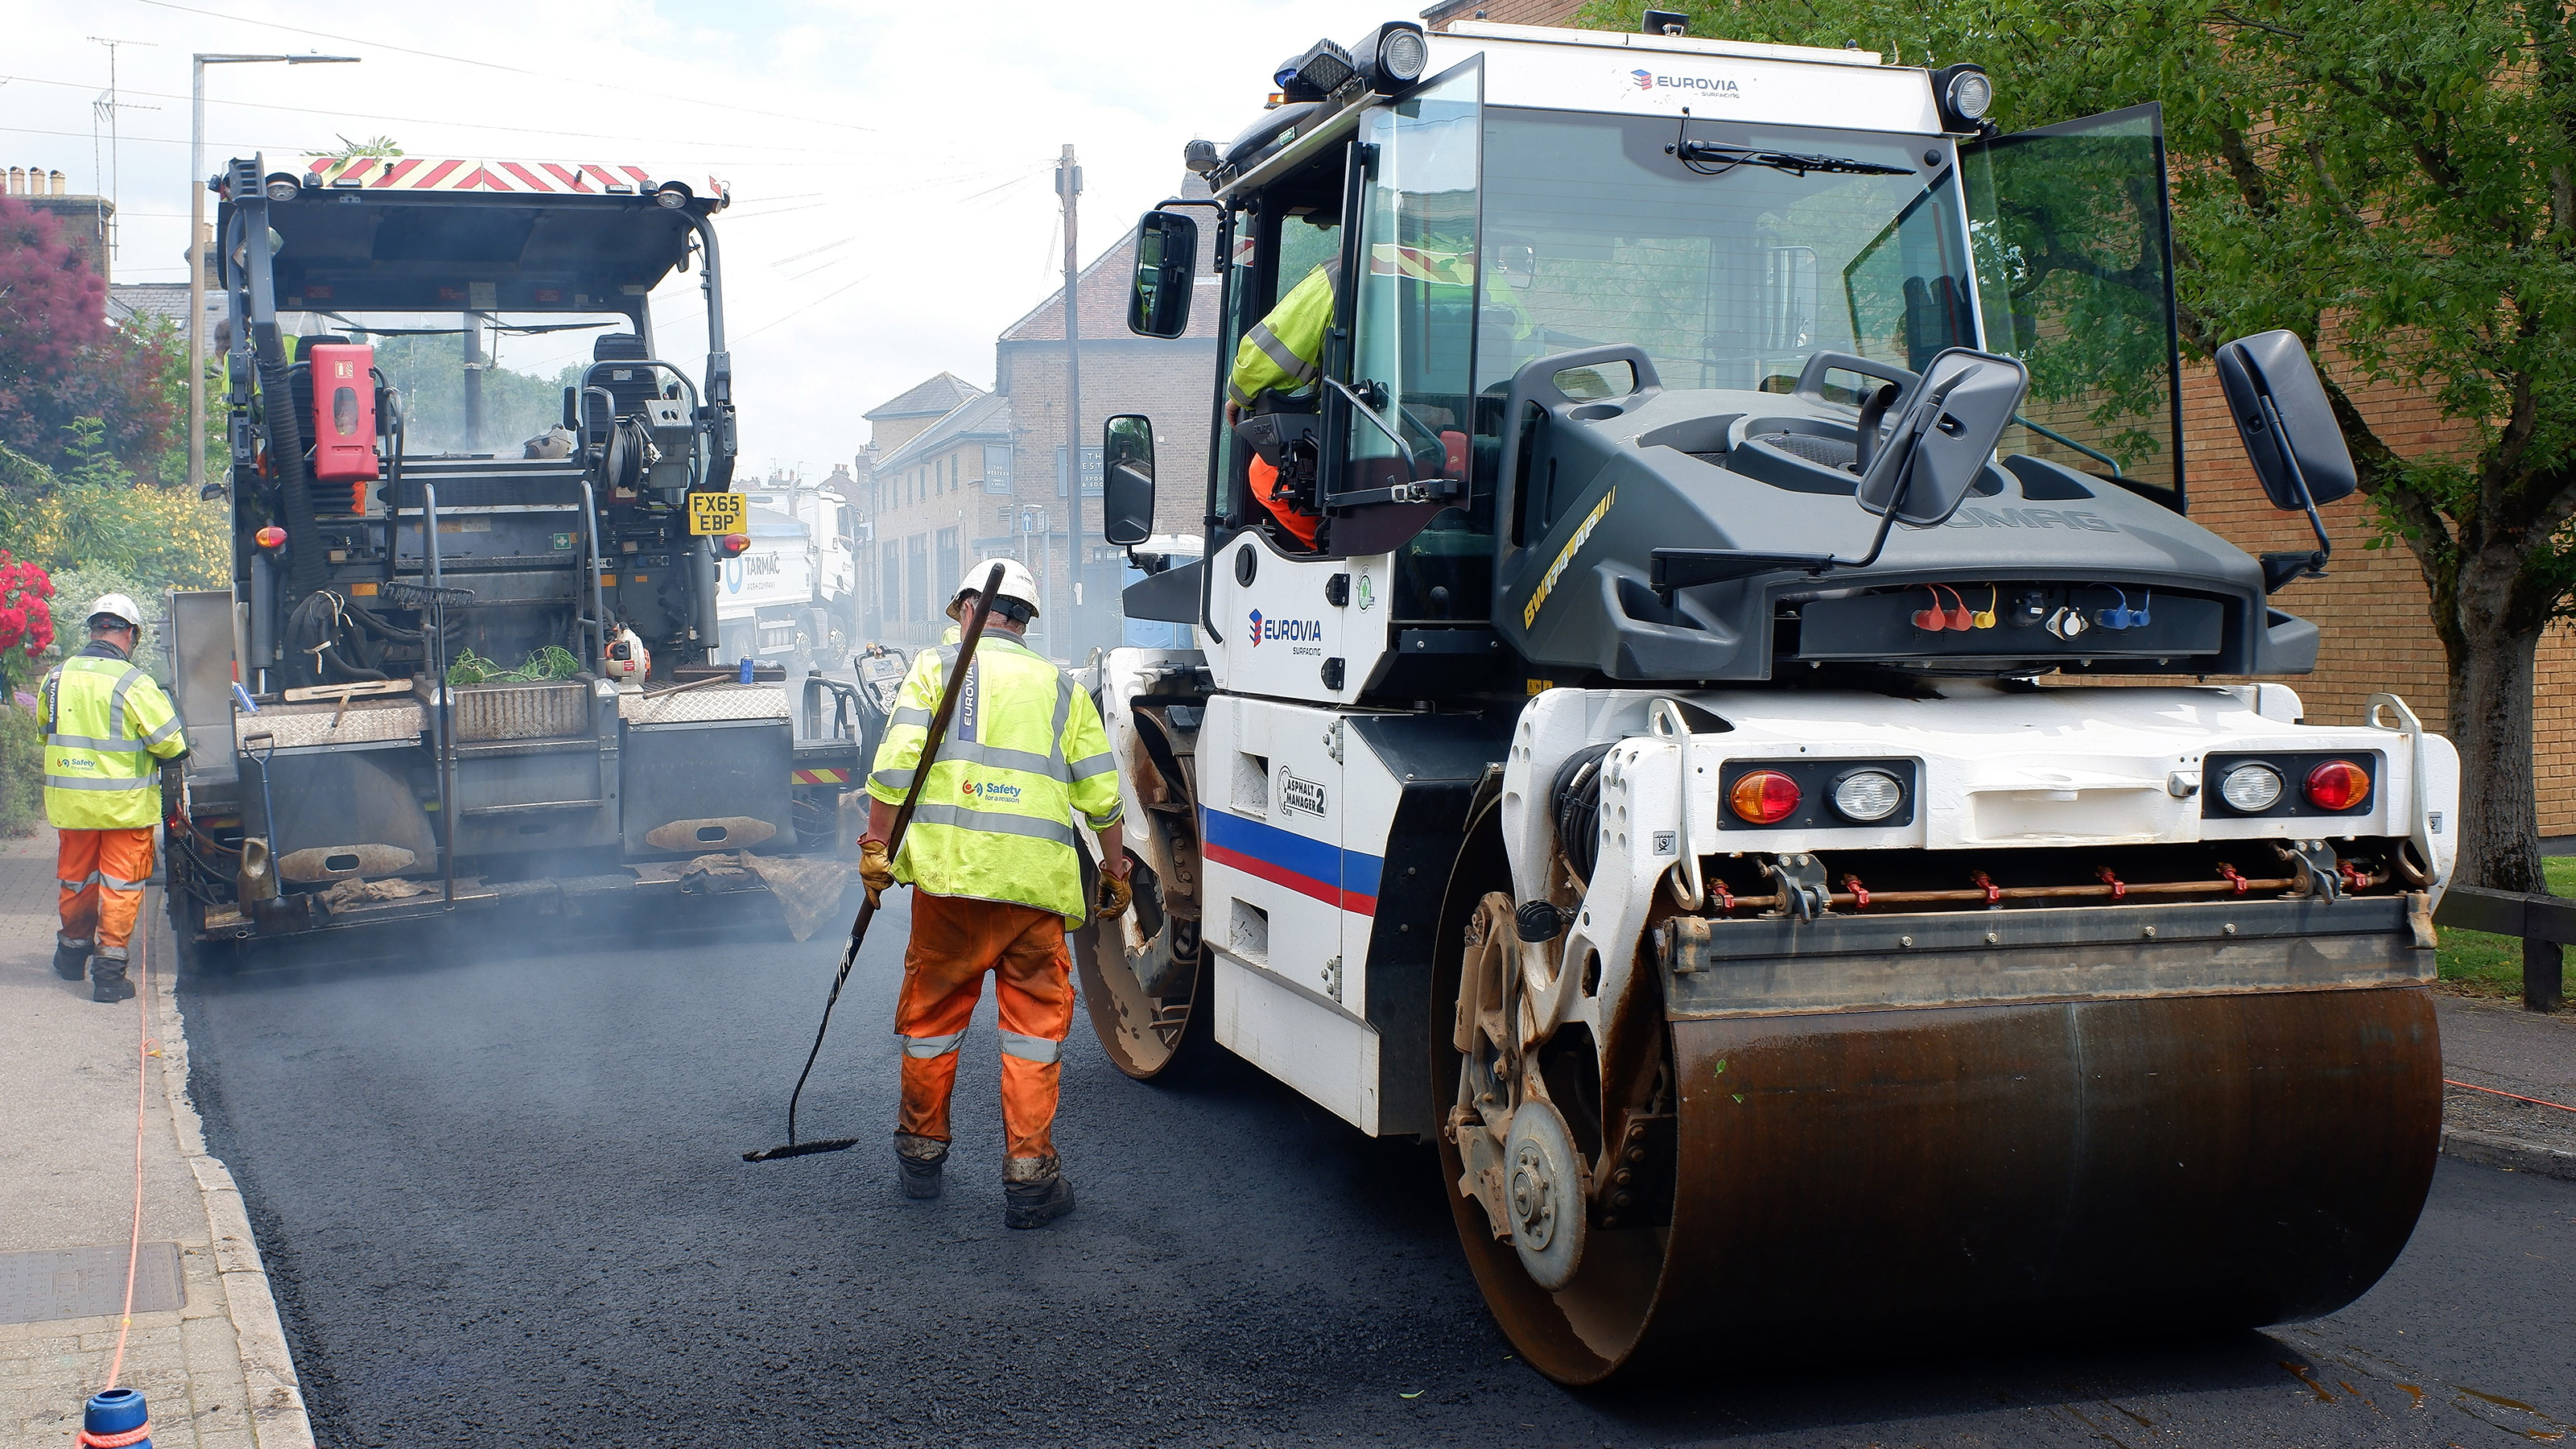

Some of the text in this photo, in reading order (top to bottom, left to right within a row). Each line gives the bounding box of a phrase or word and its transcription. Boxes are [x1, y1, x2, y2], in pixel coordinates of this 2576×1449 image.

[1657, 76, 1739, 91] EUROVIA
[693, 495, 740, 512] FX65
[700, 514, 734, 530] EBP
[1894, 506, 2120, 533] OMAG
[745, 555, 780, 576] TARMAC
[1265, 619, 1322, 642] EUROVIA
[1292, 646, 1322, 656] SURFACING
[48, 682, 57, 723] EUROVIA
[964, 666, 974, 726] EUROVIA
[72, 758, 96, 768] Safety
[986, 782, 1022, 797] Safety
[1287, 778, 1314, 797] ASPHALT
[1286, 787, 1324, 815] MANAGER 2
